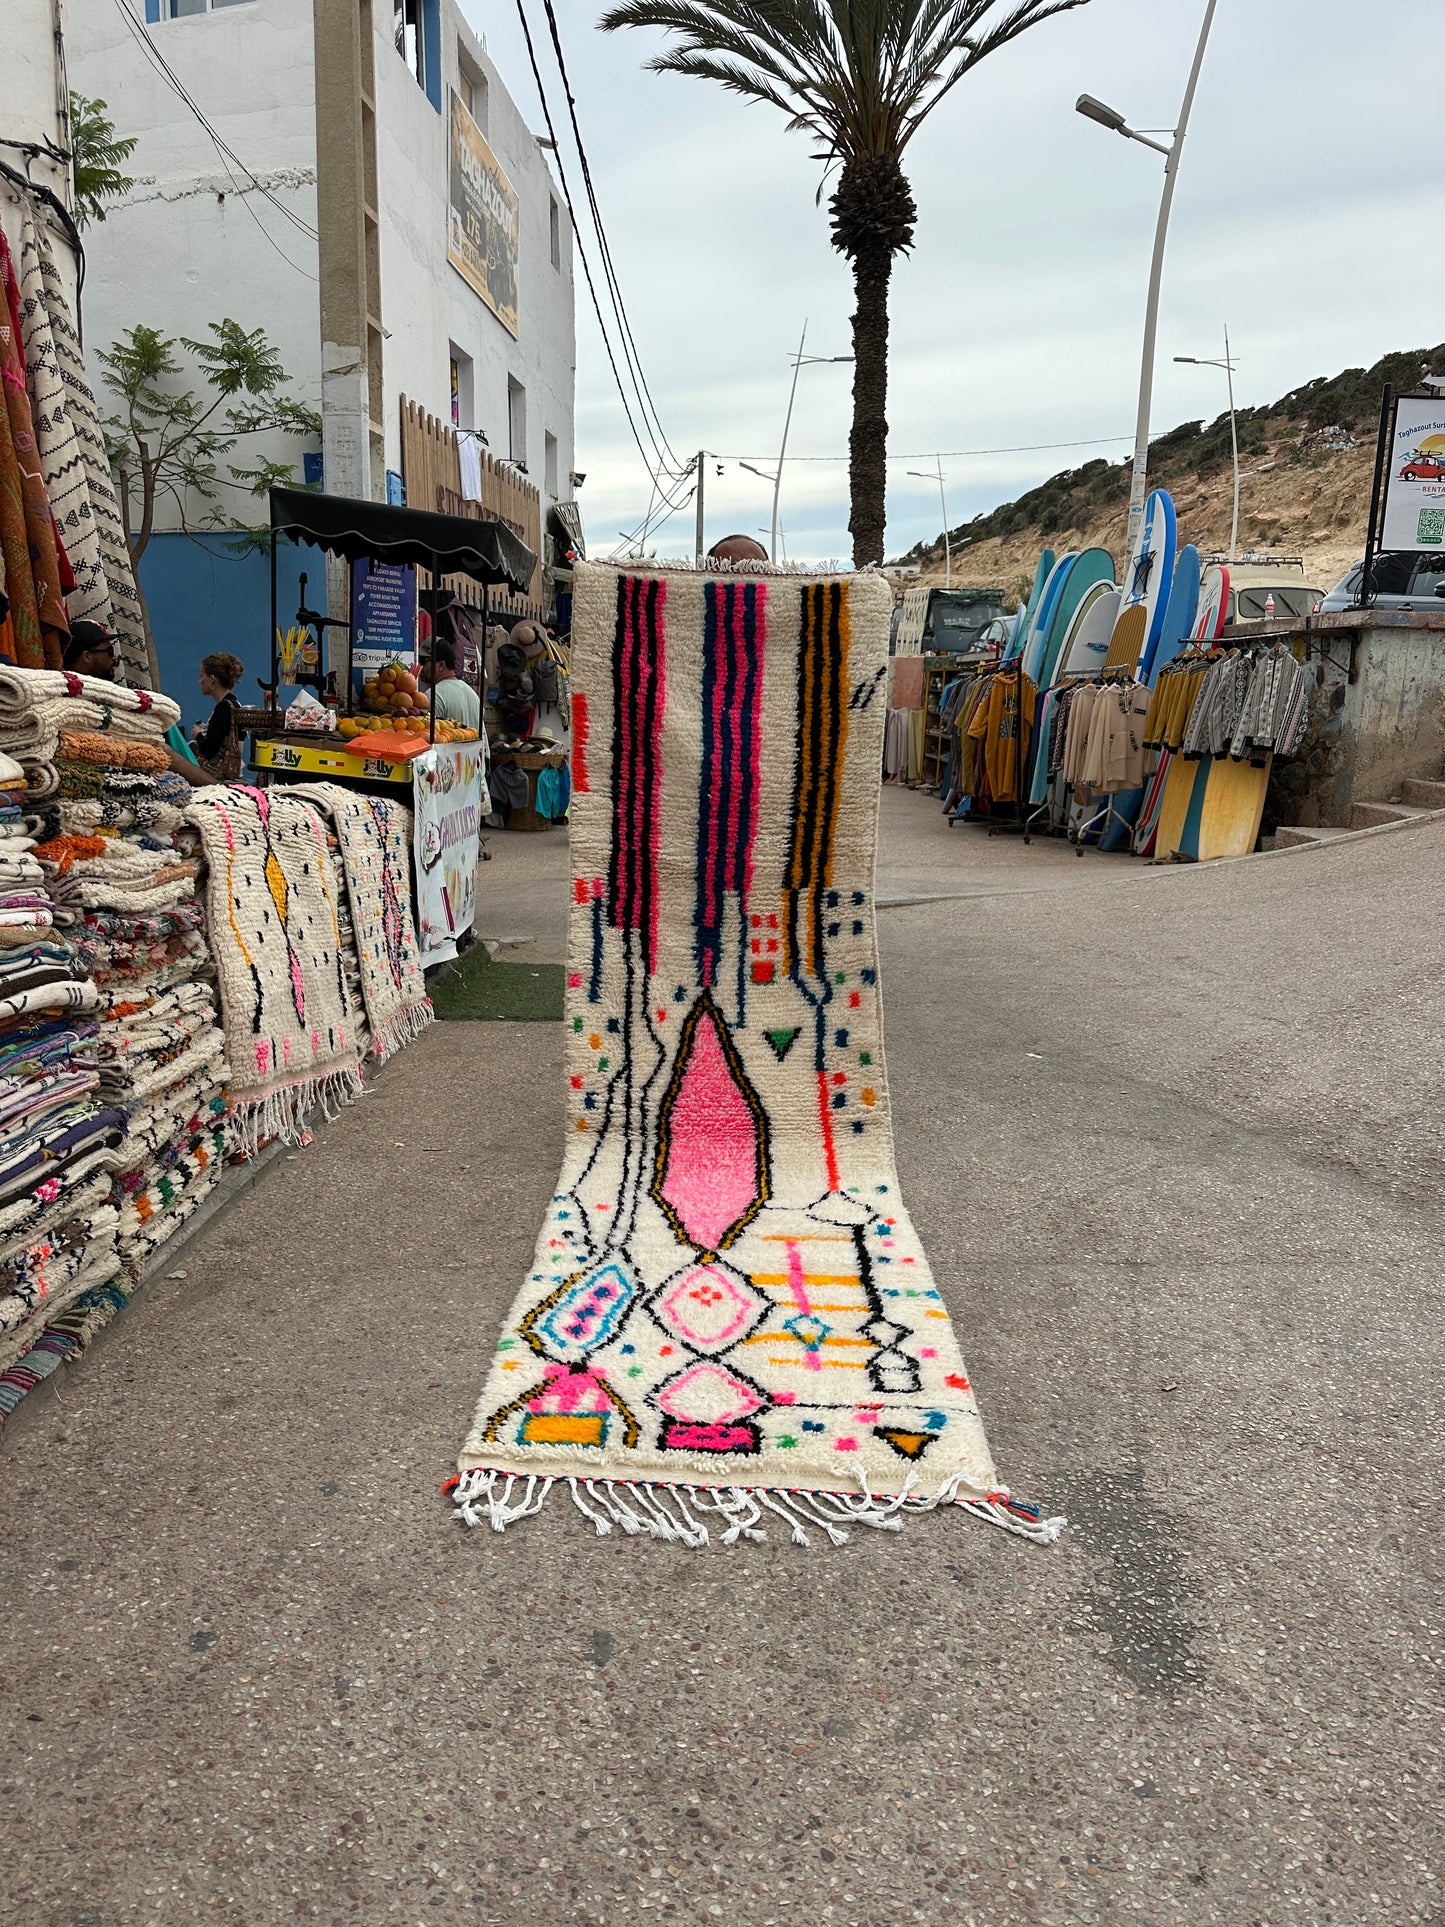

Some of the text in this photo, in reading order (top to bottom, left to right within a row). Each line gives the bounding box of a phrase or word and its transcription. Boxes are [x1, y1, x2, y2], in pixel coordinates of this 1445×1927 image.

[459, 134, 512, 242] TAGHAZOUT
[466, 211, 482, 246] 175
[1398, 423, 1431, 439] Taghazout
